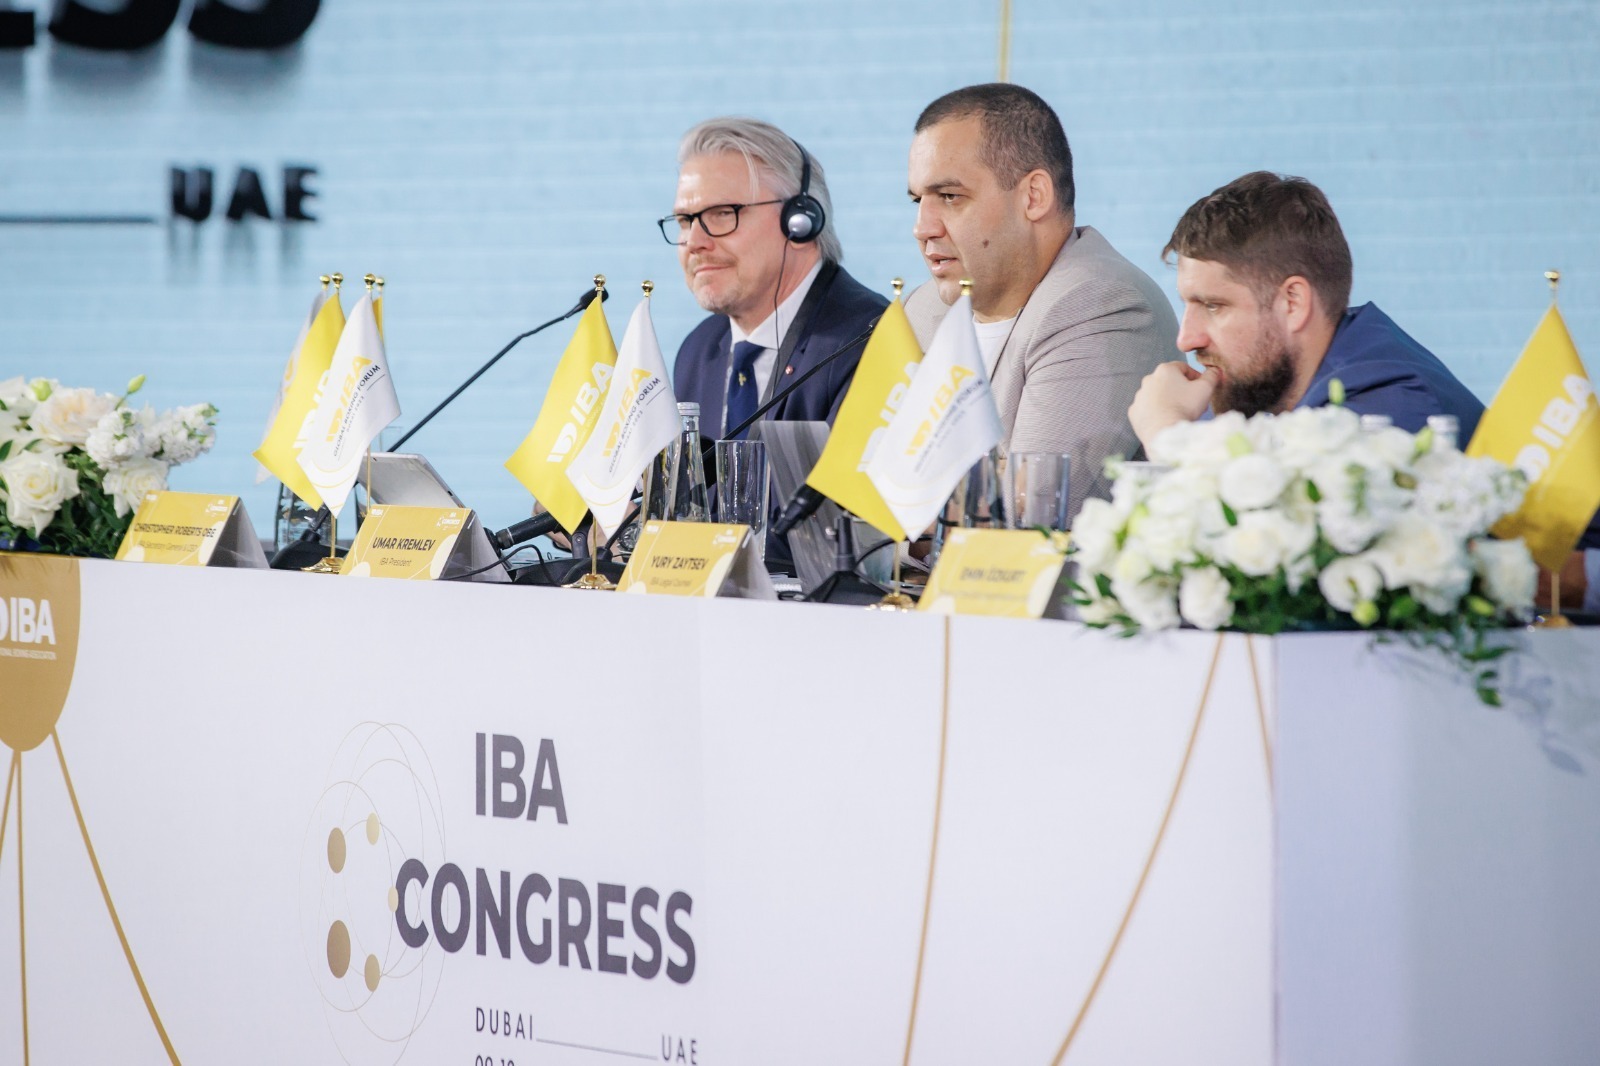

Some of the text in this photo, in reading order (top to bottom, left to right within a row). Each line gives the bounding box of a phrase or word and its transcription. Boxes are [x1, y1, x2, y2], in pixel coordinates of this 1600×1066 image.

[169, 166, 318, 222] UAE
[358, 365, 382, 392] FORUM
[636, 377, 662, 406] FORUM
[372, 537, 436, 551] UMAR KREMLEV
[651, 555, 709, 570] YURY ZAYTSEV
[10, 597, 56, 645] IBA
[475, 732, 568, 825] IBA
[394, 858, 697, 985] CONGRESS
[475, 1007, 698, 1065] DUBAI UAE
